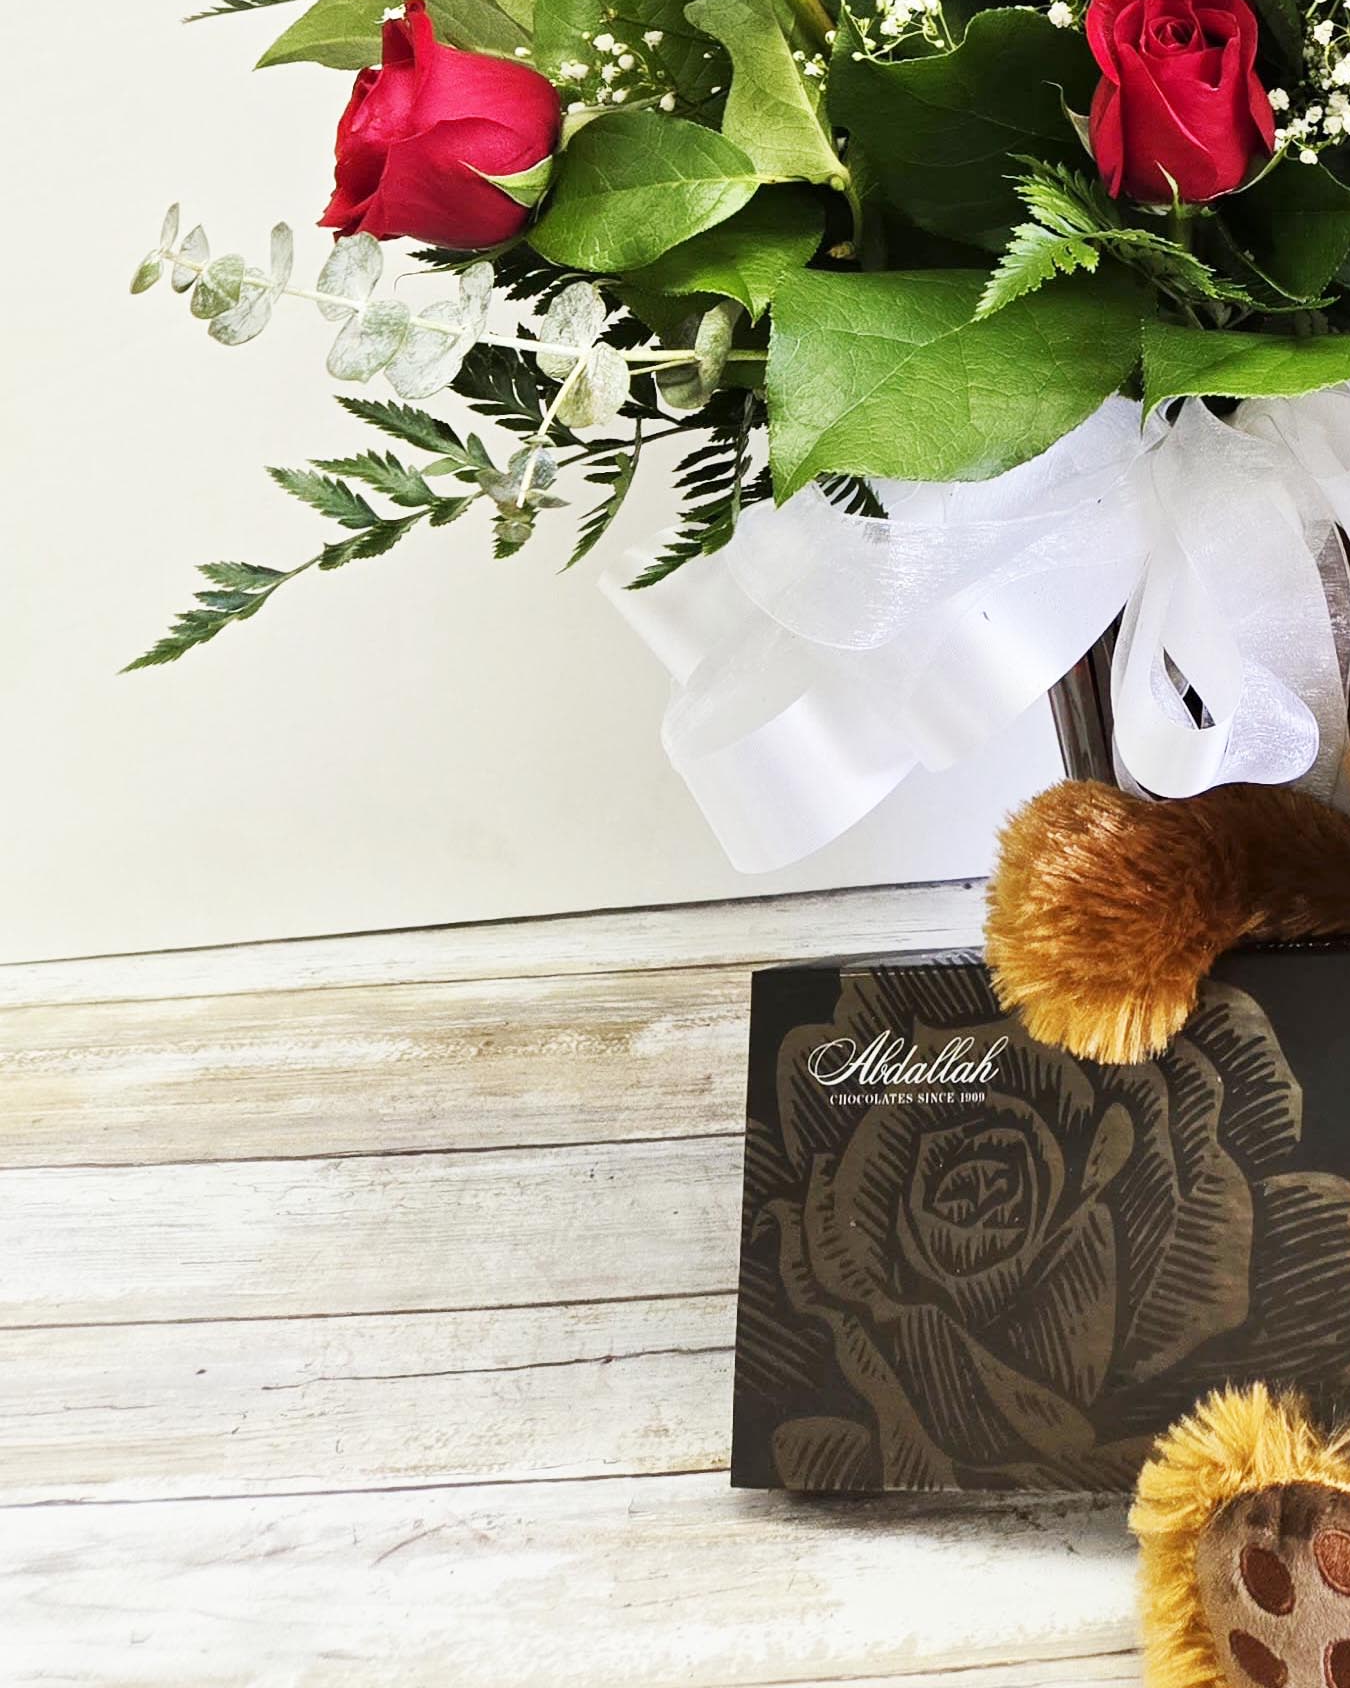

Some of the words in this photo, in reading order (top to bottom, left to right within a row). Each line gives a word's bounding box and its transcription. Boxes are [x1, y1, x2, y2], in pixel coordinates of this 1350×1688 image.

[808, 1029, 1009, 1086] Abdallah
[829, 1092, 913, 1105] CHOCOLATES
[917, 1092, 955, 1104] SINCE
[960, 1092, 985, 1104] 1909
